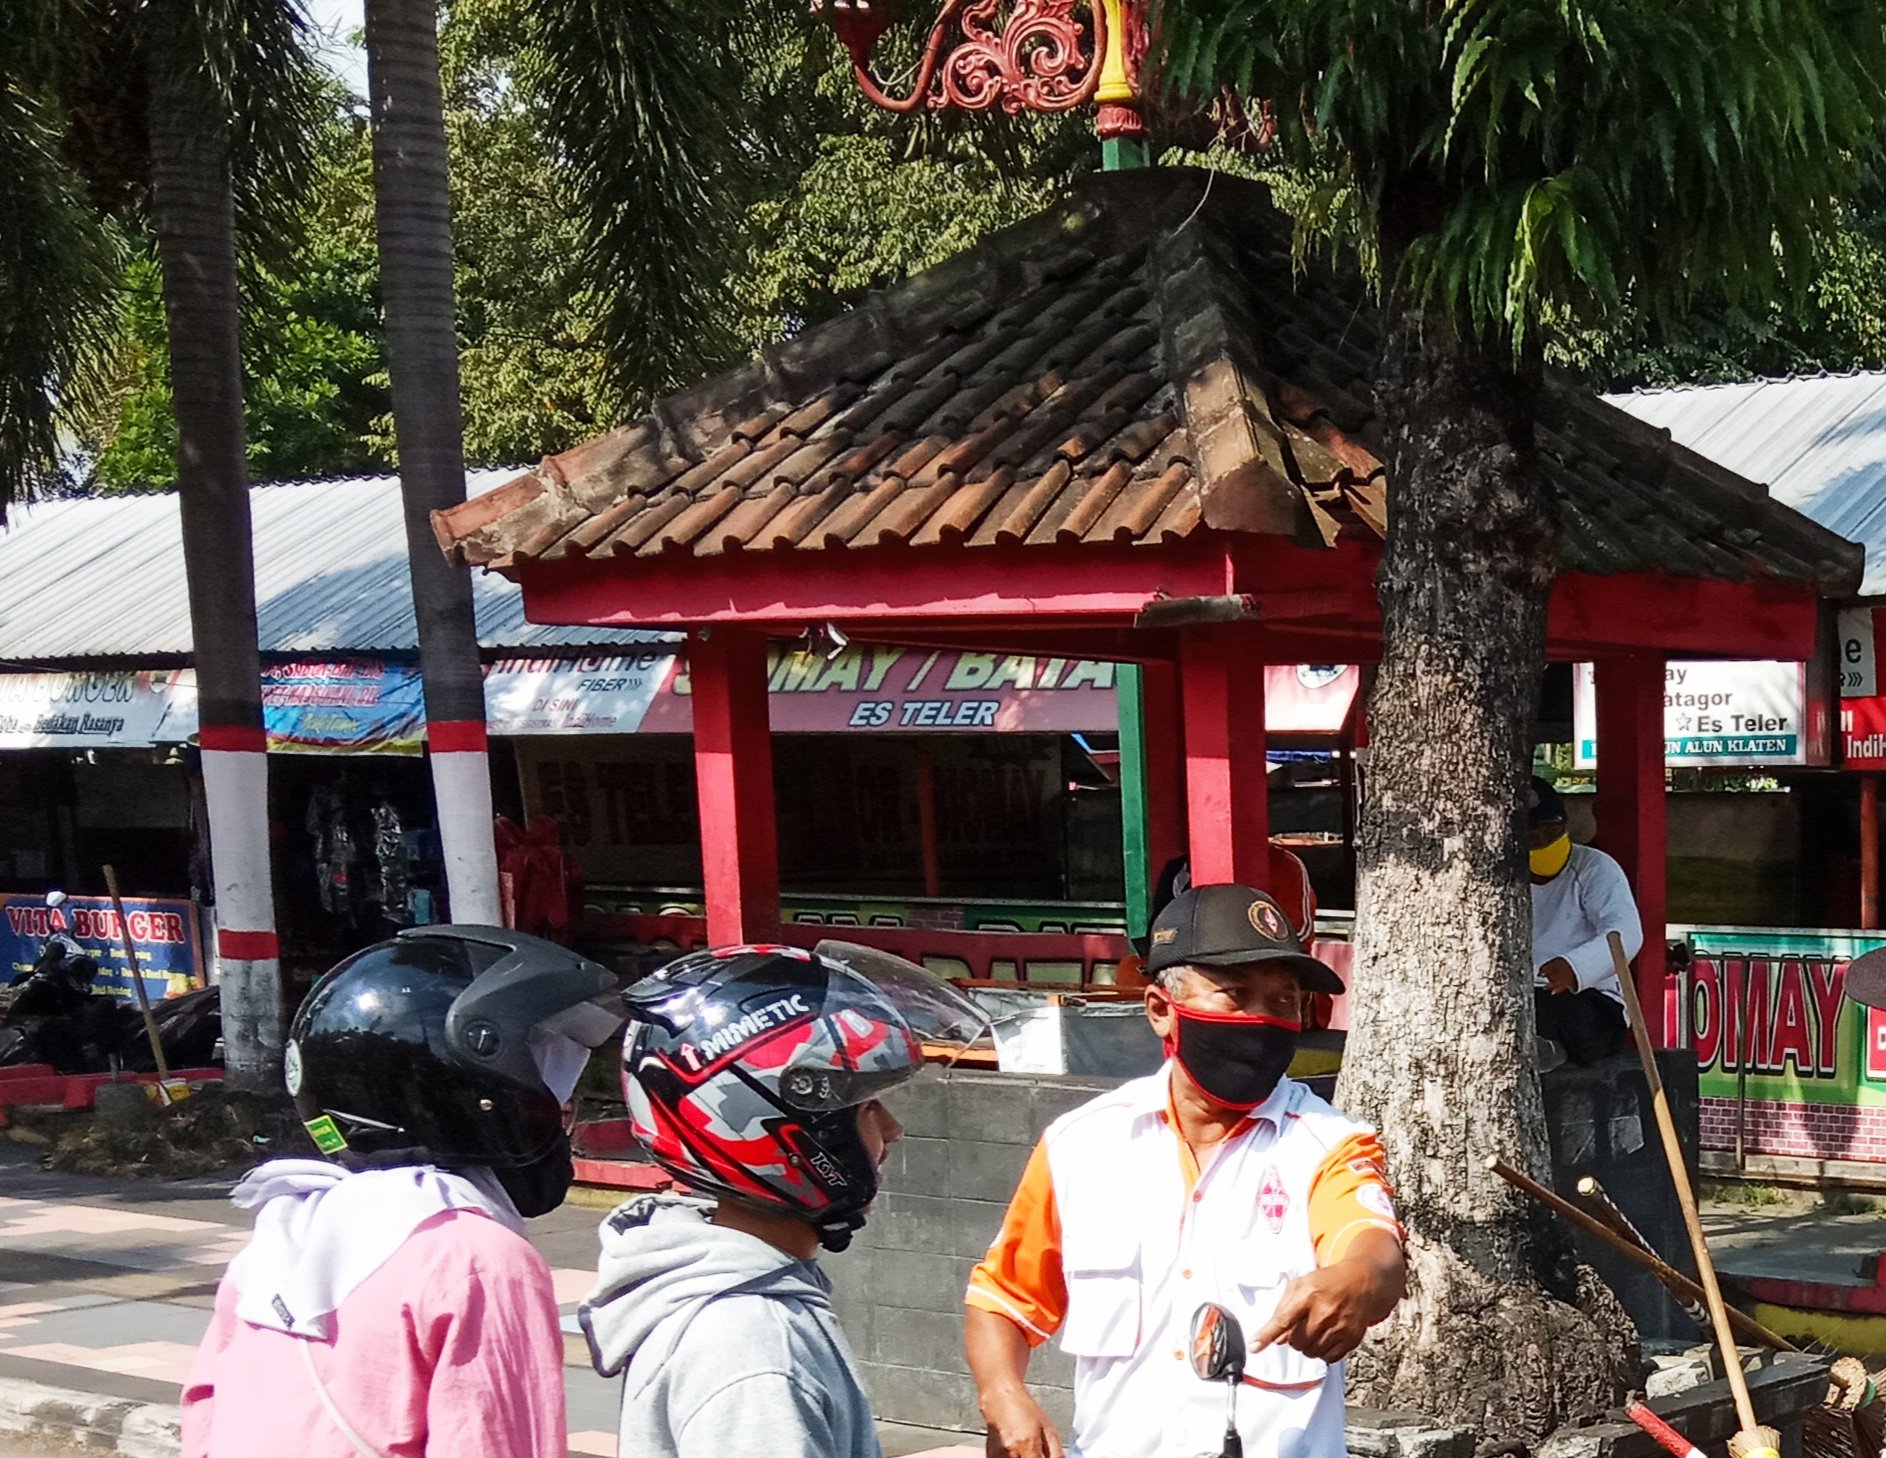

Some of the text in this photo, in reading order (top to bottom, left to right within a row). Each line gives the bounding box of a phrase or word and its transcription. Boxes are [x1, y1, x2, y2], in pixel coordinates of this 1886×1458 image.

[907, 650, 939, 692] /
[946, 652, 1118, 693] BATA
[576, 678, 628, 692] FIBER
[1664, 691, 1733, 710] atagor
[849, 701, 1000, 727] ES TELER
[1697, 714, 1788, 733] Es Teler
[1684, 739, 1725, 754] ALUN
[1728, 738, 1787, 752] KLATEN
[6, 906, 186, 944] VITA BURGER
[700, 994, 810, 1061] MIMETIC
[1665, 951, 1855, 1079] IOMAY
